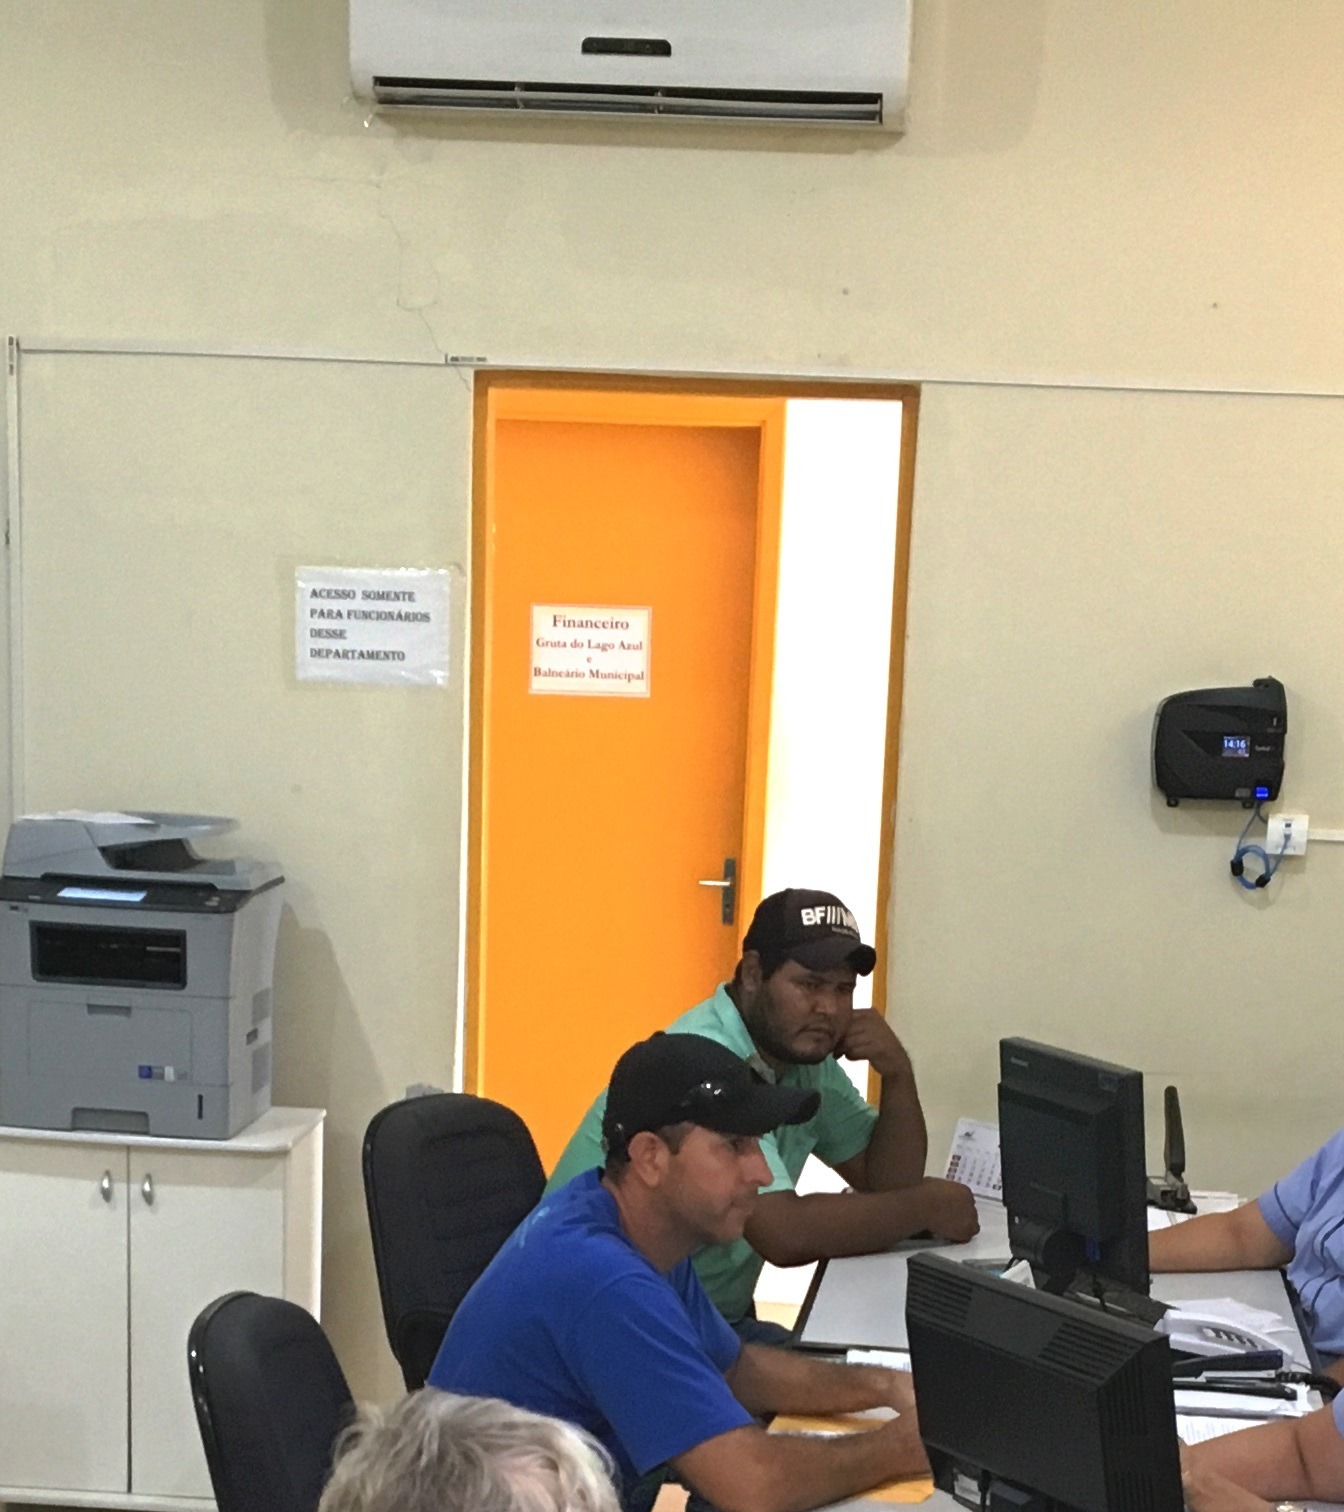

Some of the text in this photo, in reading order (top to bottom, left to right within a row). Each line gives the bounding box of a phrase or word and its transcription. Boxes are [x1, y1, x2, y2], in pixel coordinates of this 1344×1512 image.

[310, 587, 416, 603] ACESSO SOMENTE
[310, 608, 431, 623] PARA FUNCIONÁRIOS
[552, 614, 630, 631] Financeiro
[310, 627, 347, 640] DESSE
[535, 637, 644, 653] Gruta do Lago Azul
[310, 647, 406, 662] DEPARTAMENTO
[586, 656, 593, 664] e
[533, 667, 645, 682] Balneário Municipal
[1223, 739, 1246, 748] 14:16
